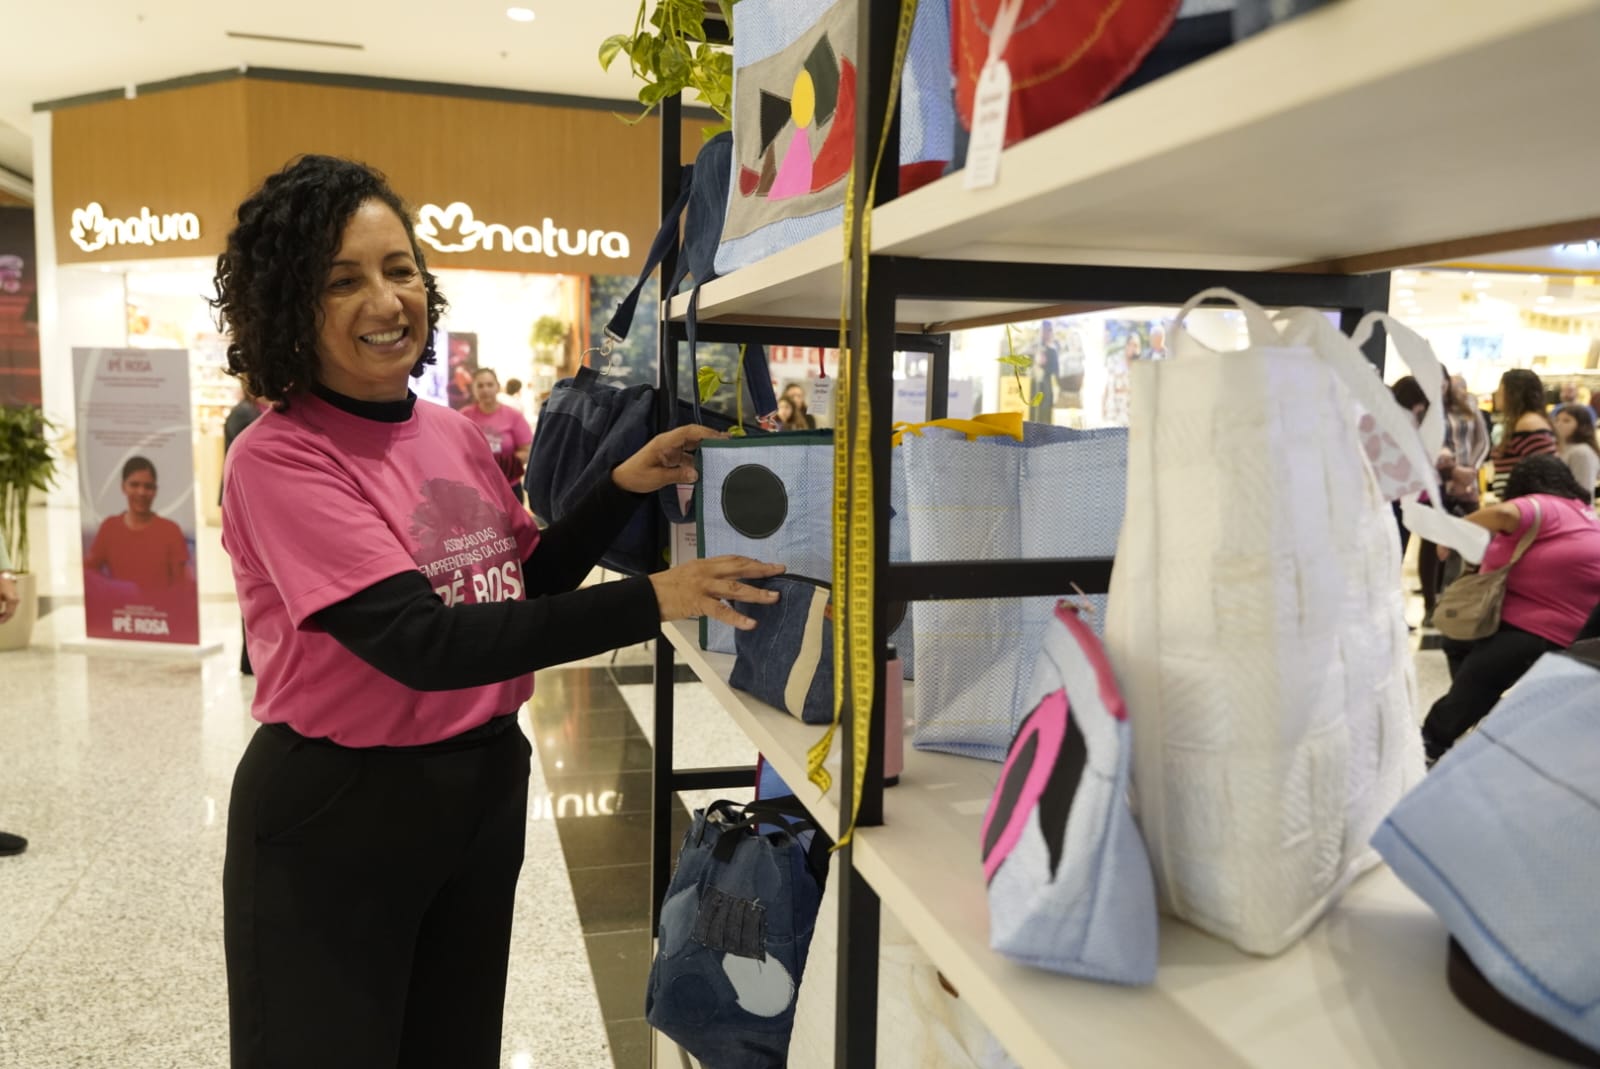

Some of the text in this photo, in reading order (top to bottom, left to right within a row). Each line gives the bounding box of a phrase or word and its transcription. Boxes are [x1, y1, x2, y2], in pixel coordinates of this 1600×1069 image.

[104, 206, 200, 246] natura
[483, 217, 630, 258] natura
[476, 526, 498, 544] DAS
[480, 544, 496, 559] DA
[435, 558, 527, 608] PÊ ROS
[111, 613, 134, 633] IPÊ
[134, 617, 171, 635] ROSA
